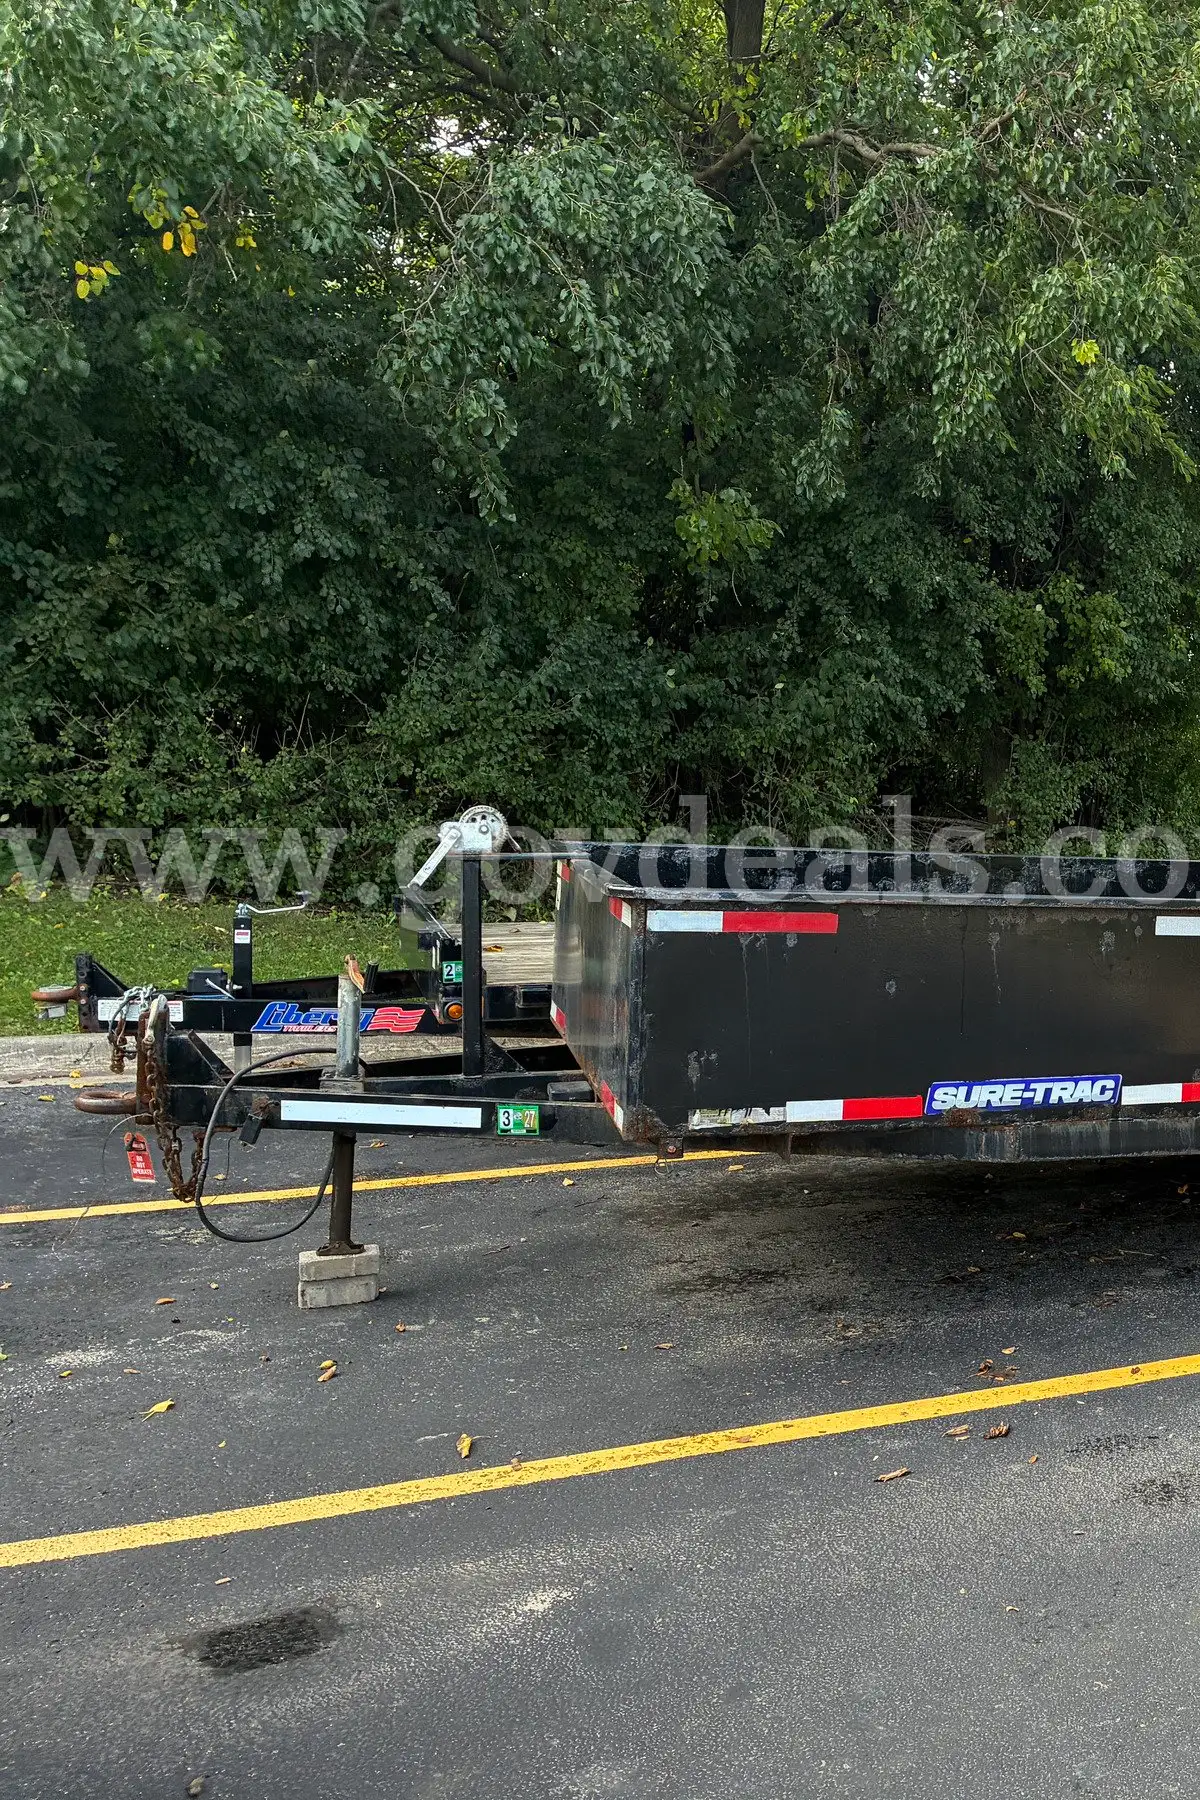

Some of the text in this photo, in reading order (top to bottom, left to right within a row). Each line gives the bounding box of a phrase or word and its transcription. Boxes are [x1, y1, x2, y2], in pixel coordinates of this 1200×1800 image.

[445, 964, 454, 977] 2
[251, 1001, 376, 1032] Libery
[932, 1079, 1116, 1110] SURE-TRAC
[502, 1110, 536, 1128] 3 27
